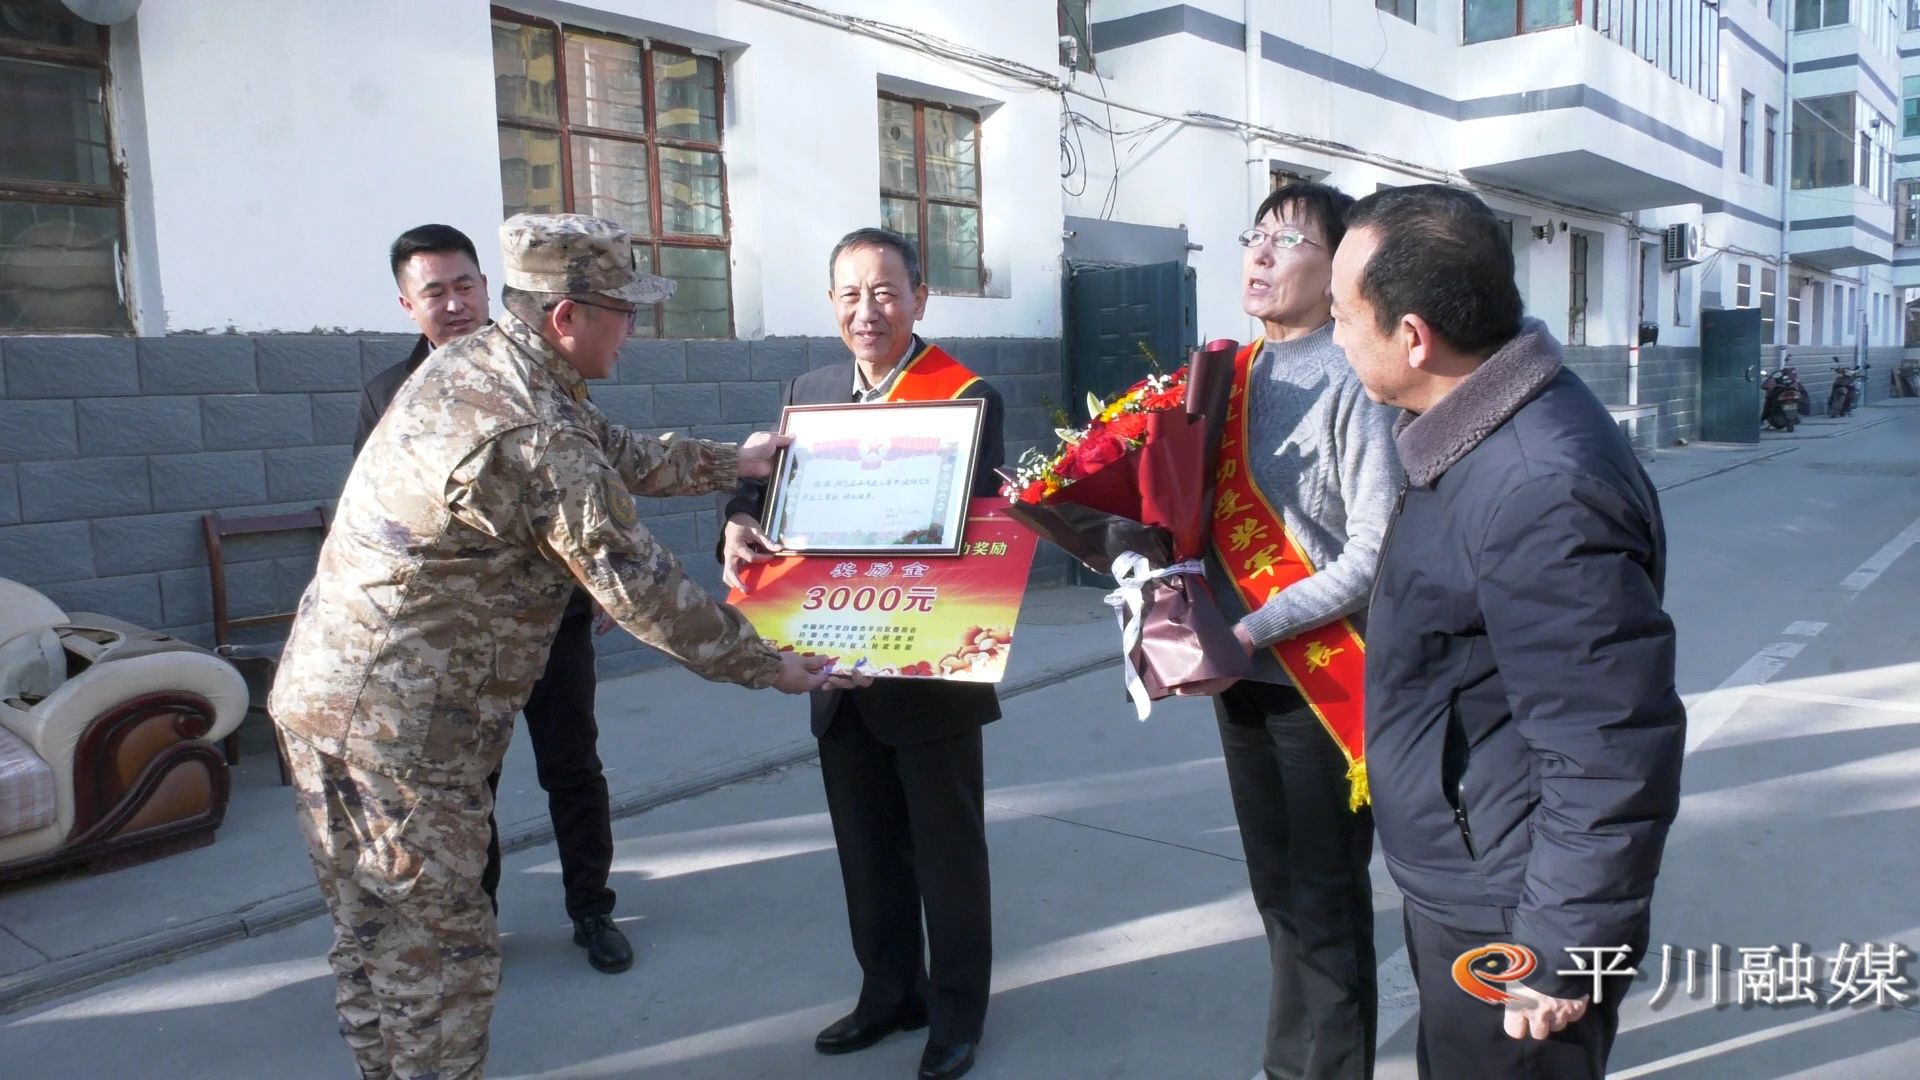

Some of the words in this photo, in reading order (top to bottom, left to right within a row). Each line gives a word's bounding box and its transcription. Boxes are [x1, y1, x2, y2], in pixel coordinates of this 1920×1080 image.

[830, 562, 930, 579] 奖励金
[802, 585, 938, 614] 3000元
